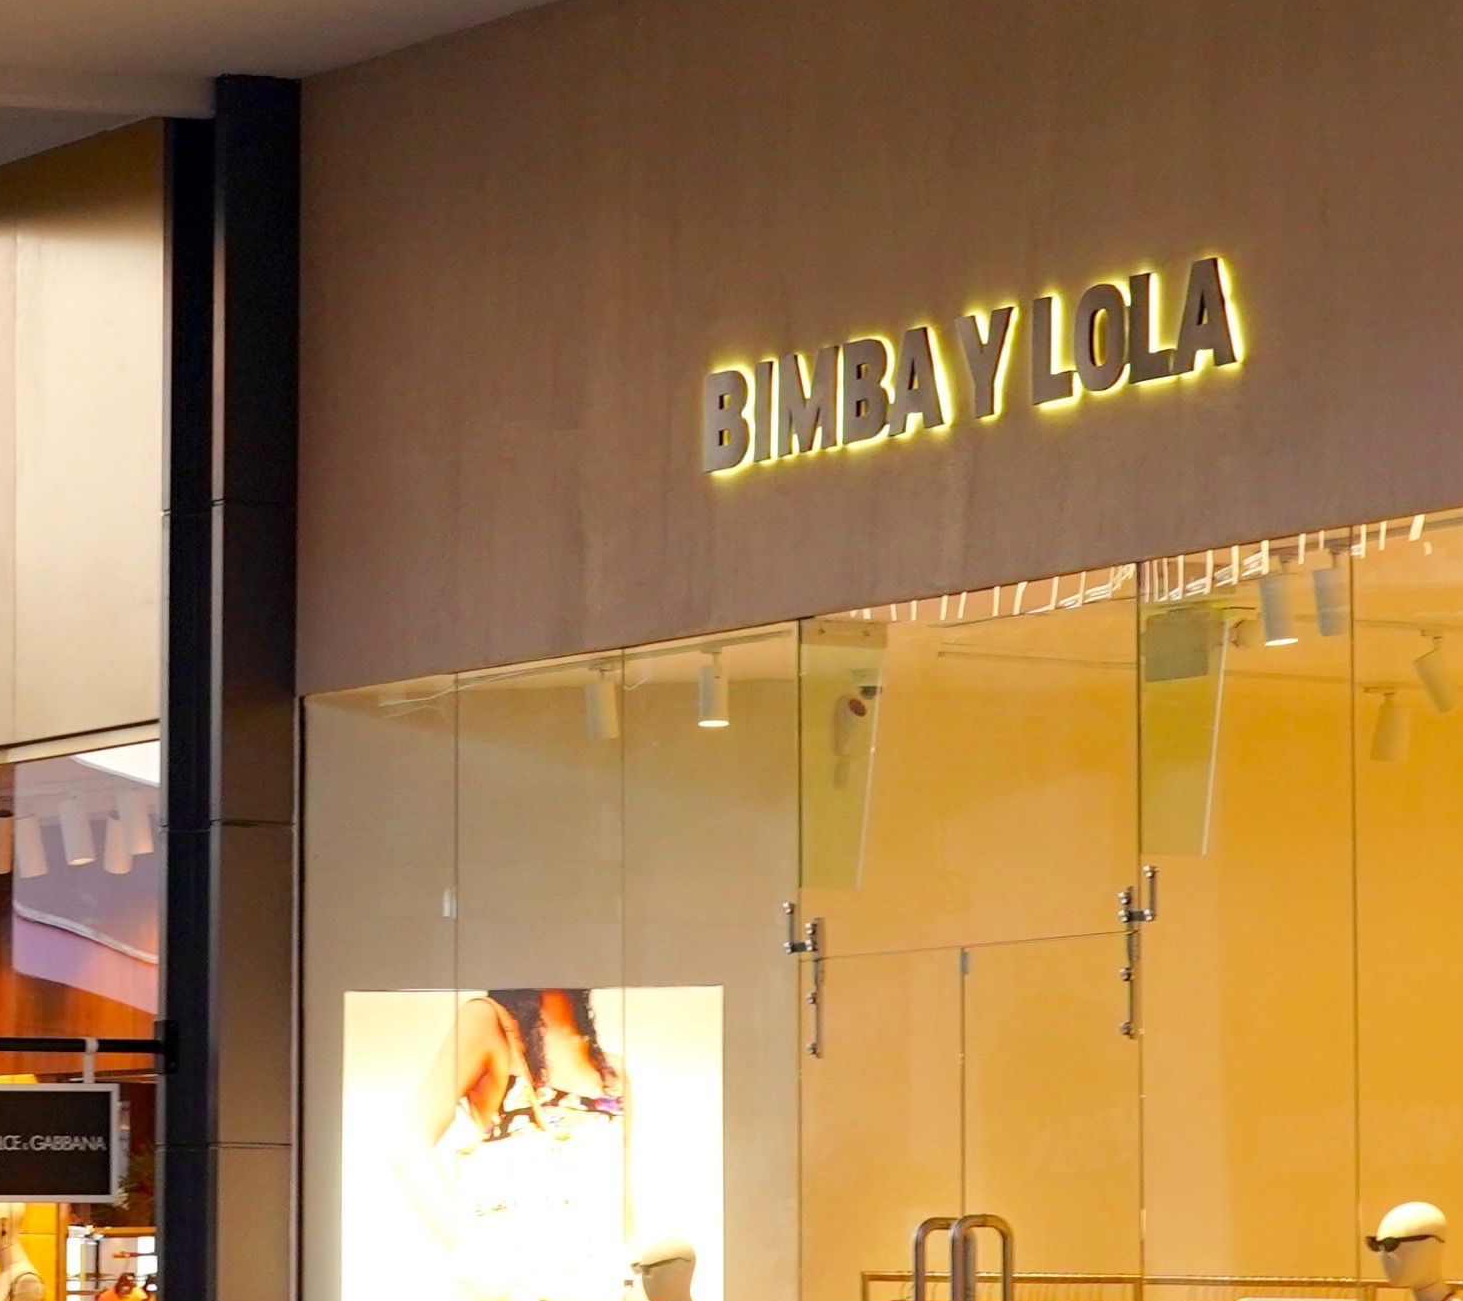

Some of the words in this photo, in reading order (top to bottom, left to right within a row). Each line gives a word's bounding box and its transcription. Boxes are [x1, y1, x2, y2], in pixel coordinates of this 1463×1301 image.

[703, 326, 951, 474] BIMBA
[956, 306, 1018, 420] Y
[1032, 256, 1243, 407] LOLA
[29, 1134, 108, 1151] GABBANA
